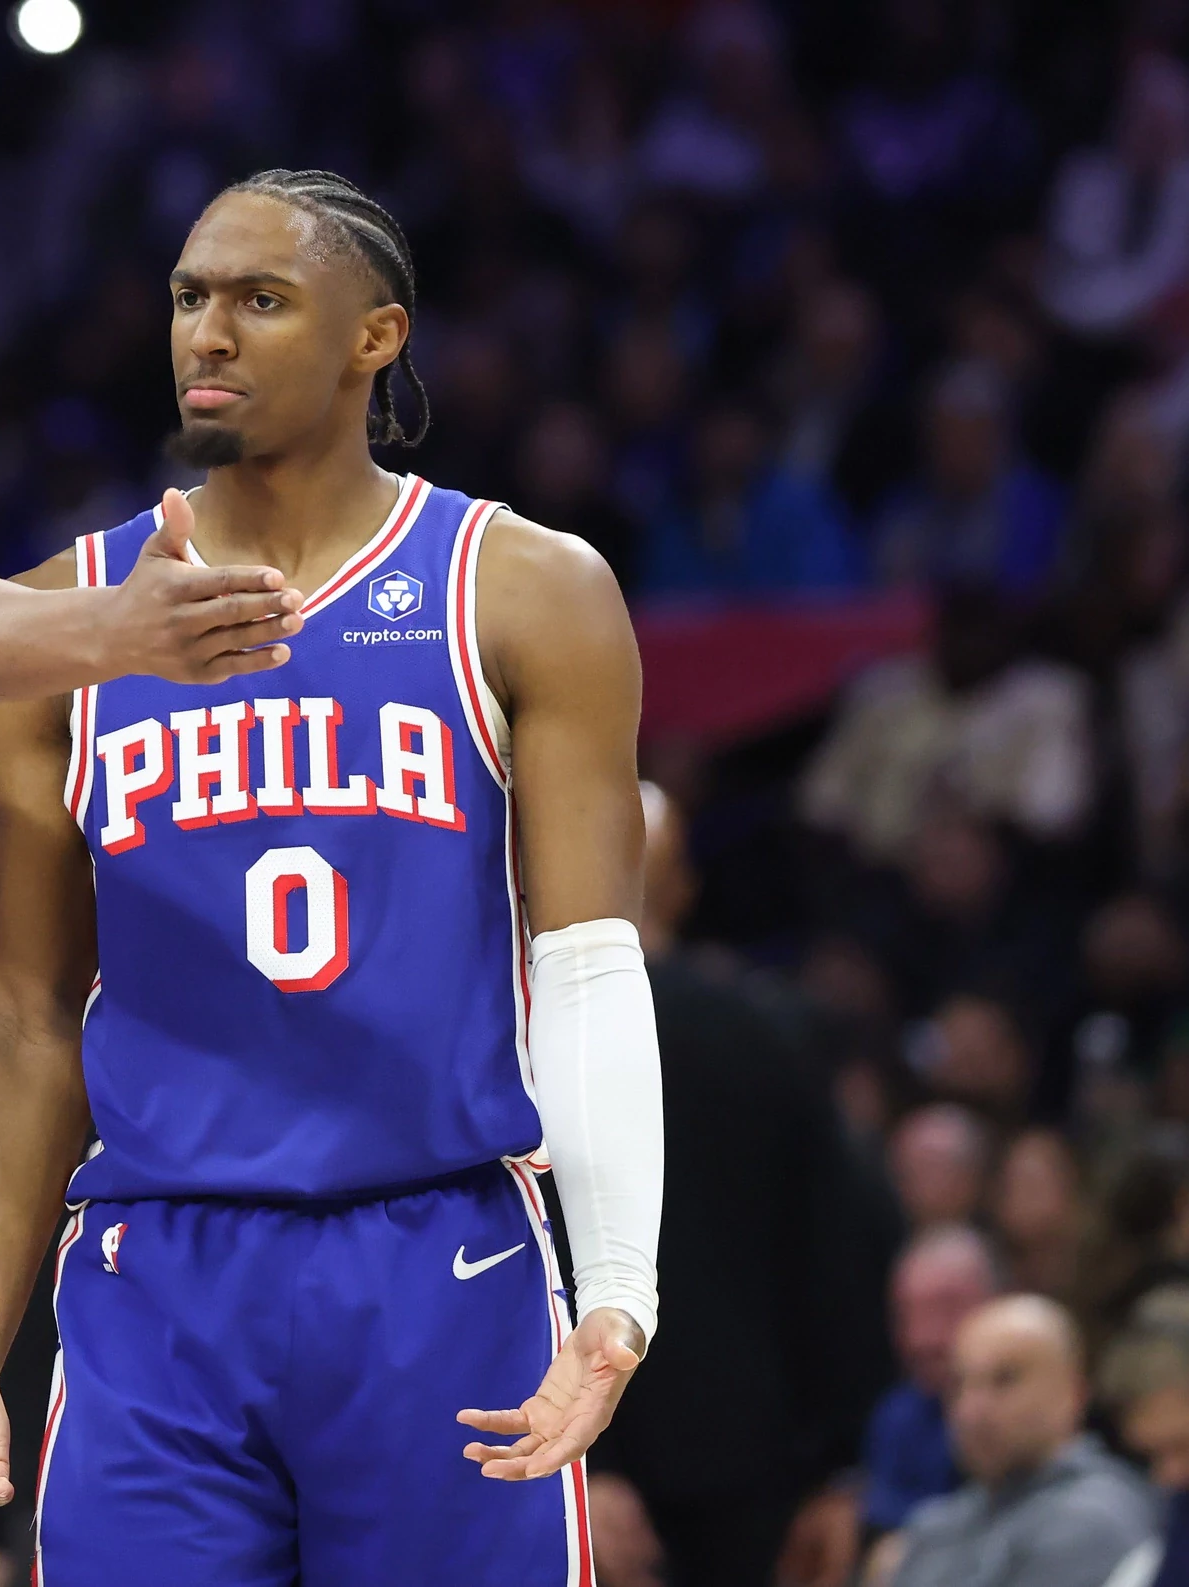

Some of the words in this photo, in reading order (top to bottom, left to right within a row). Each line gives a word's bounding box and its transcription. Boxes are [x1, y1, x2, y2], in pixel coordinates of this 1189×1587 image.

[342, 628, 443, 645] crypto.com
[96, 697, 467, 856] PHILA
[245, 845, 350, 994] 0
